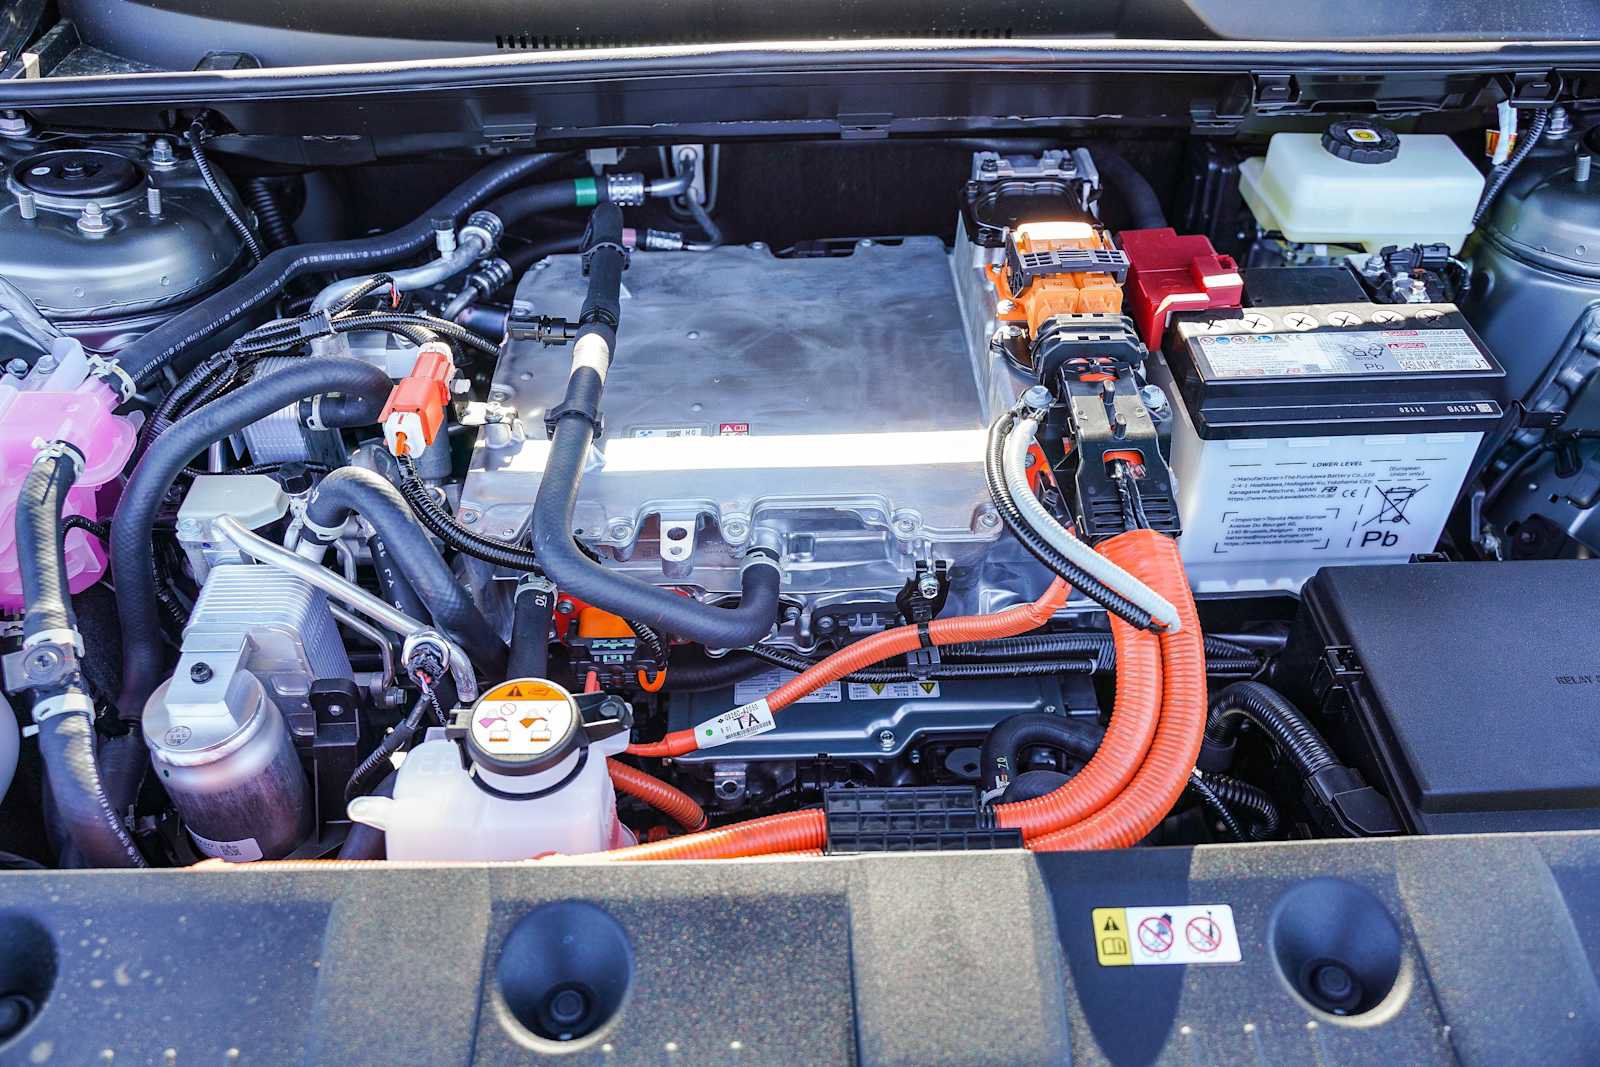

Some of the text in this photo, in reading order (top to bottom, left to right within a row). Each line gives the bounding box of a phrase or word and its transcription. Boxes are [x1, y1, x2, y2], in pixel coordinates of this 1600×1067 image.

[1363, 362, 1385, 371] Pb
[1342, 489, 1358, 498] CE
[1360, 530, 1399, 548] Pb
[733, 713, 760, 730] TA
